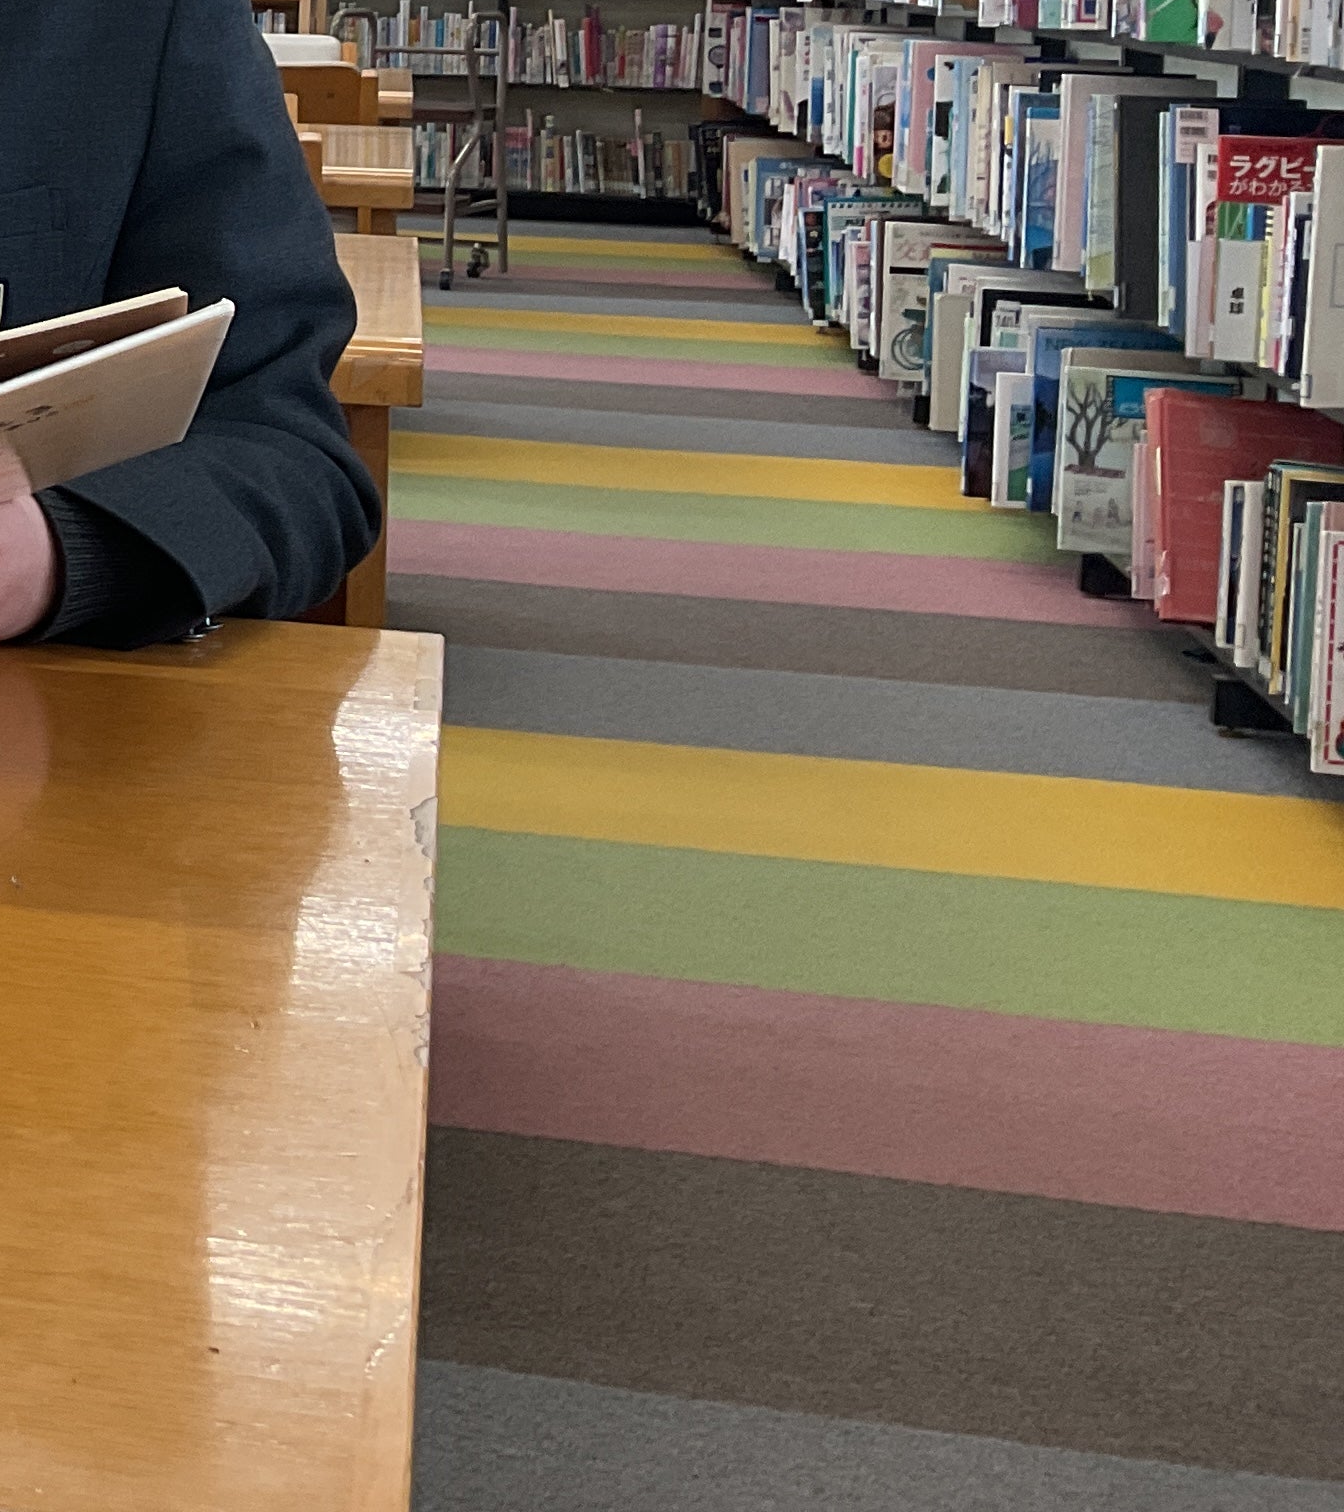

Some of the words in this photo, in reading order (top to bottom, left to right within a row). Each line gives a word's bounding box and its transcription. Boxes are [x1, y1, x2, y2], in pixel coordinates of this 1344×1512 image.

[1229, 154, 1315, 179] ラグビー
[1228, 177, 1314, 197] がわかる
